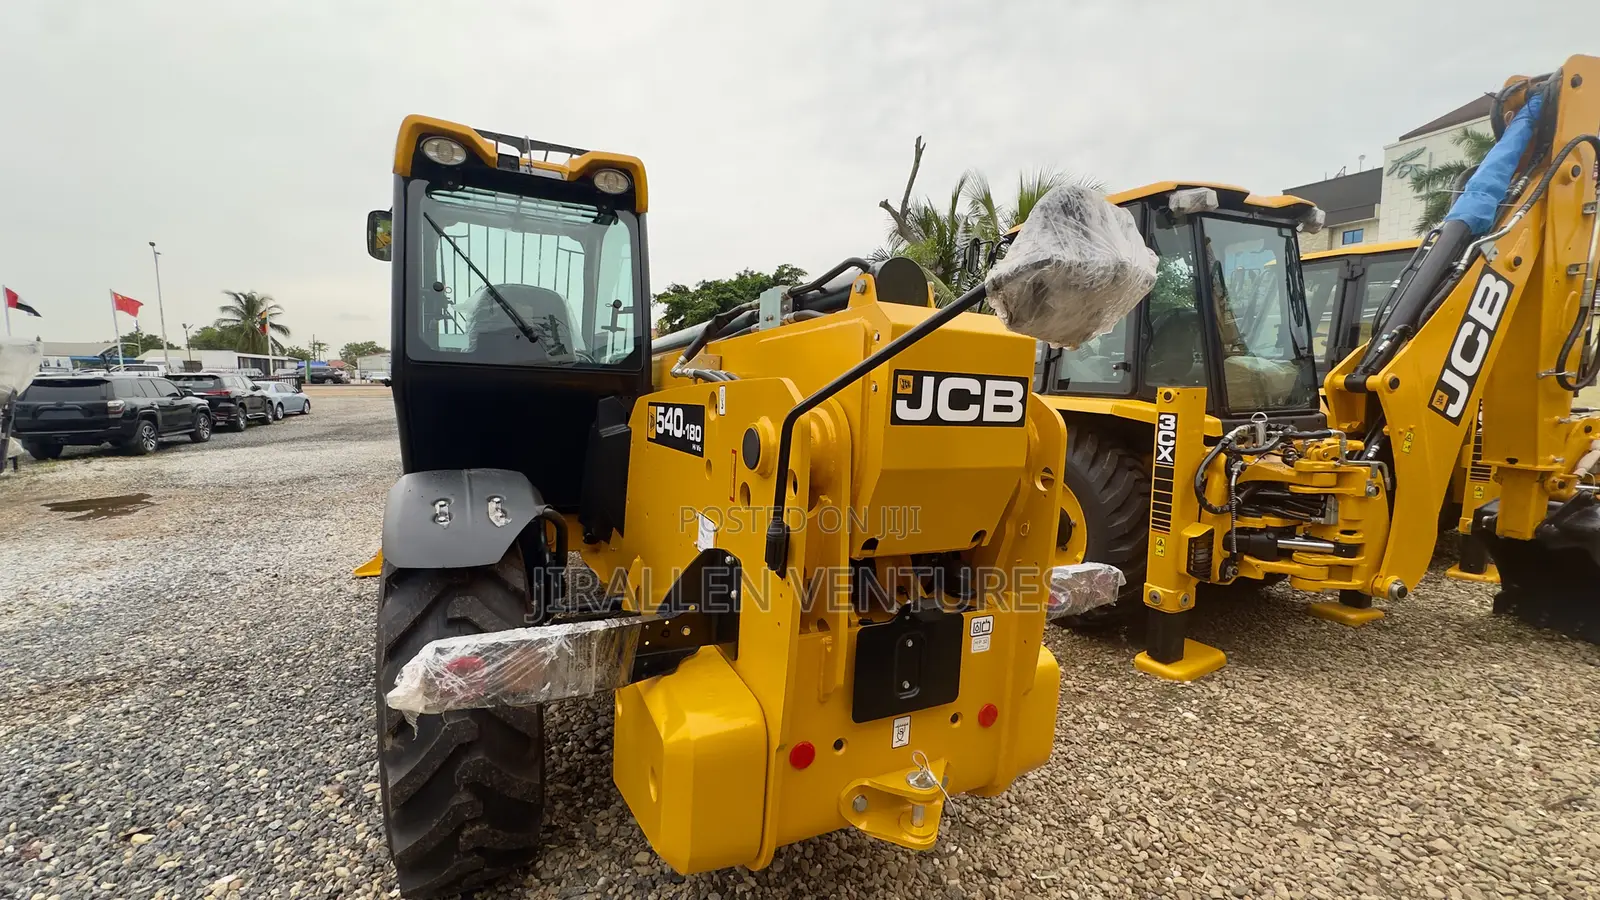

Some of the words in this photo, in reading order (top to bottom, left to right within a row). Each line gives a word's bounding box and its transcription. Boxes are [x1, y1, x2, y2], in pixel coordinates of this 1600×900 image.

[1442, 273, 1508, 418] JCB
[896, 376, 1024, 422] JCB
[656, 406, 702, 443] 540-180
[1156, 414, 1176, 463] 3CX
